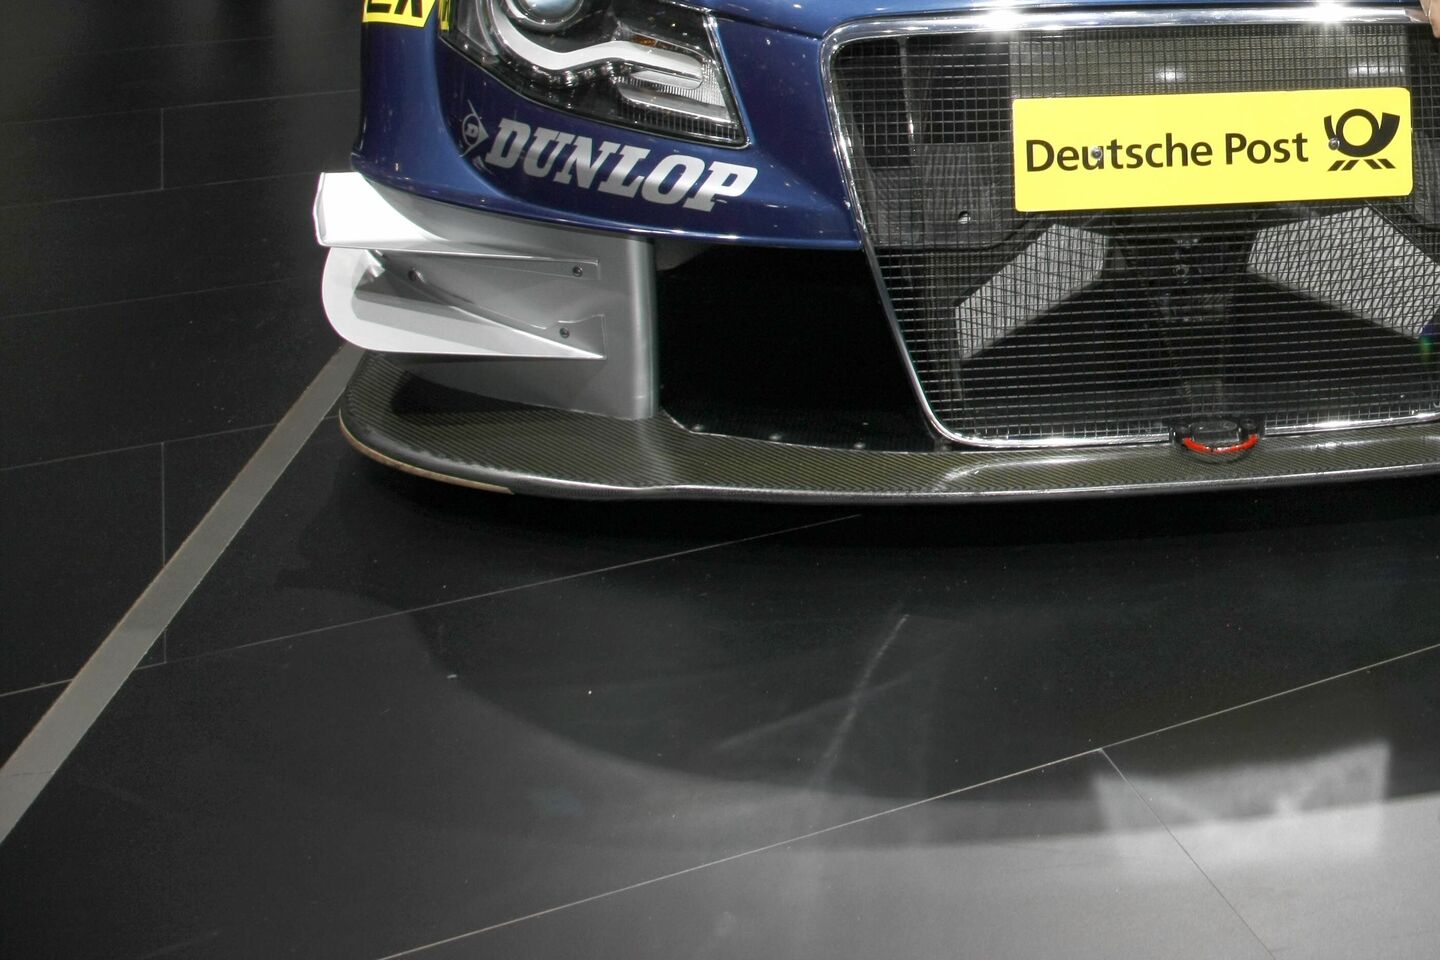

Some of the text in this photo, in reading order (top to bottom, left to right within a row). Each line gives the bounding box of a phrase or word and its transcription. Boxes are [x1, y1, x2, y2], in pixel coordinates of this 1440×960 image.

[486, 118, 758, 212] DUNLOP
[1026, 132, 1309, 172] Deutsche Post
